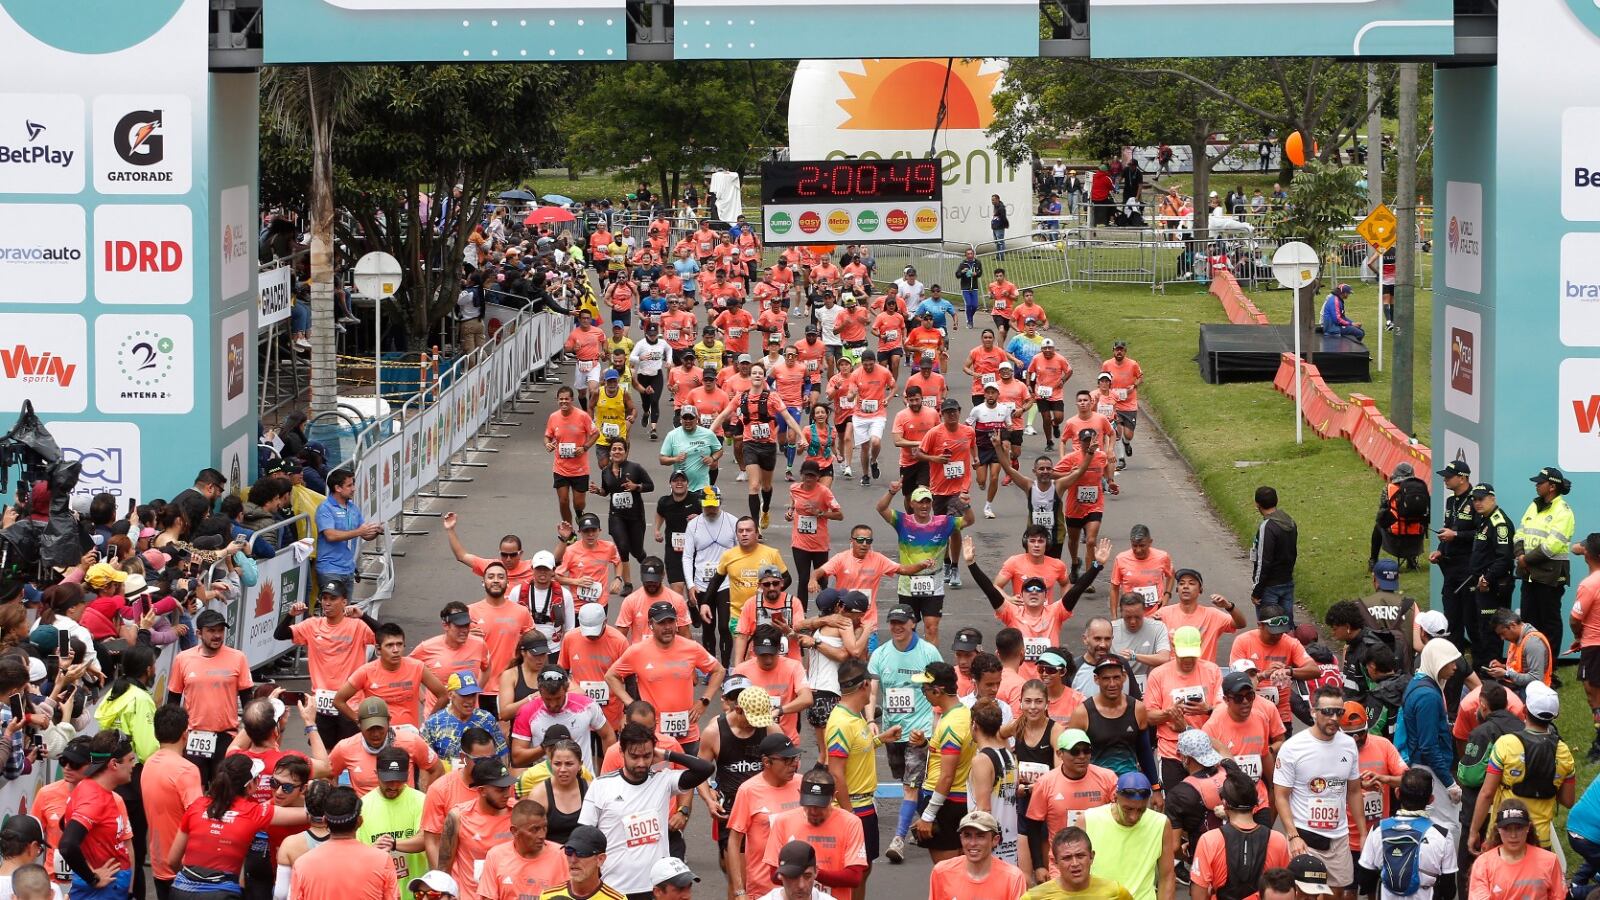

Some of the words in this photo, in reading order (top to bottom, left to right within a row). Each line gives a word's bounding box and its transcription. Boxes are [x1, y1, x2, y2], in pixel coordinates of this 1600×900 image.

[0, 146, 74, 167] BetPlay
[107, 172, 173, 181] GATORADE
[770, 219, 792, 227] JUMBO
[800, 217, 821, 228] easy
[828, 217, 850, 225] Metro
[857, 217, 879, 225] JUMBO
[886, 215, 907, 226] easy
[915, 215, 937, 223] Metro
[105, 240, 183, 272] IDRD
[22, 375, 55, 384] sports
[913, 581, 931, 590] 4069
[581, 587, 598, 597] 6712
[1367, 605, 1404, 621] PRENS
[318, 696, 336, 709] 505
[889, 695, 911, 707] 8368
[665, 719, 687, 731] 7569
[190, 737, 211, 751] 4763
[730, 760, 762, 772] ether
[1364, 799, 1382, 813] 453
[1310, 806, 1339, 820] 16034
[628, 818, 660, 837] 15076
[393, 856, 406, 871] 90
